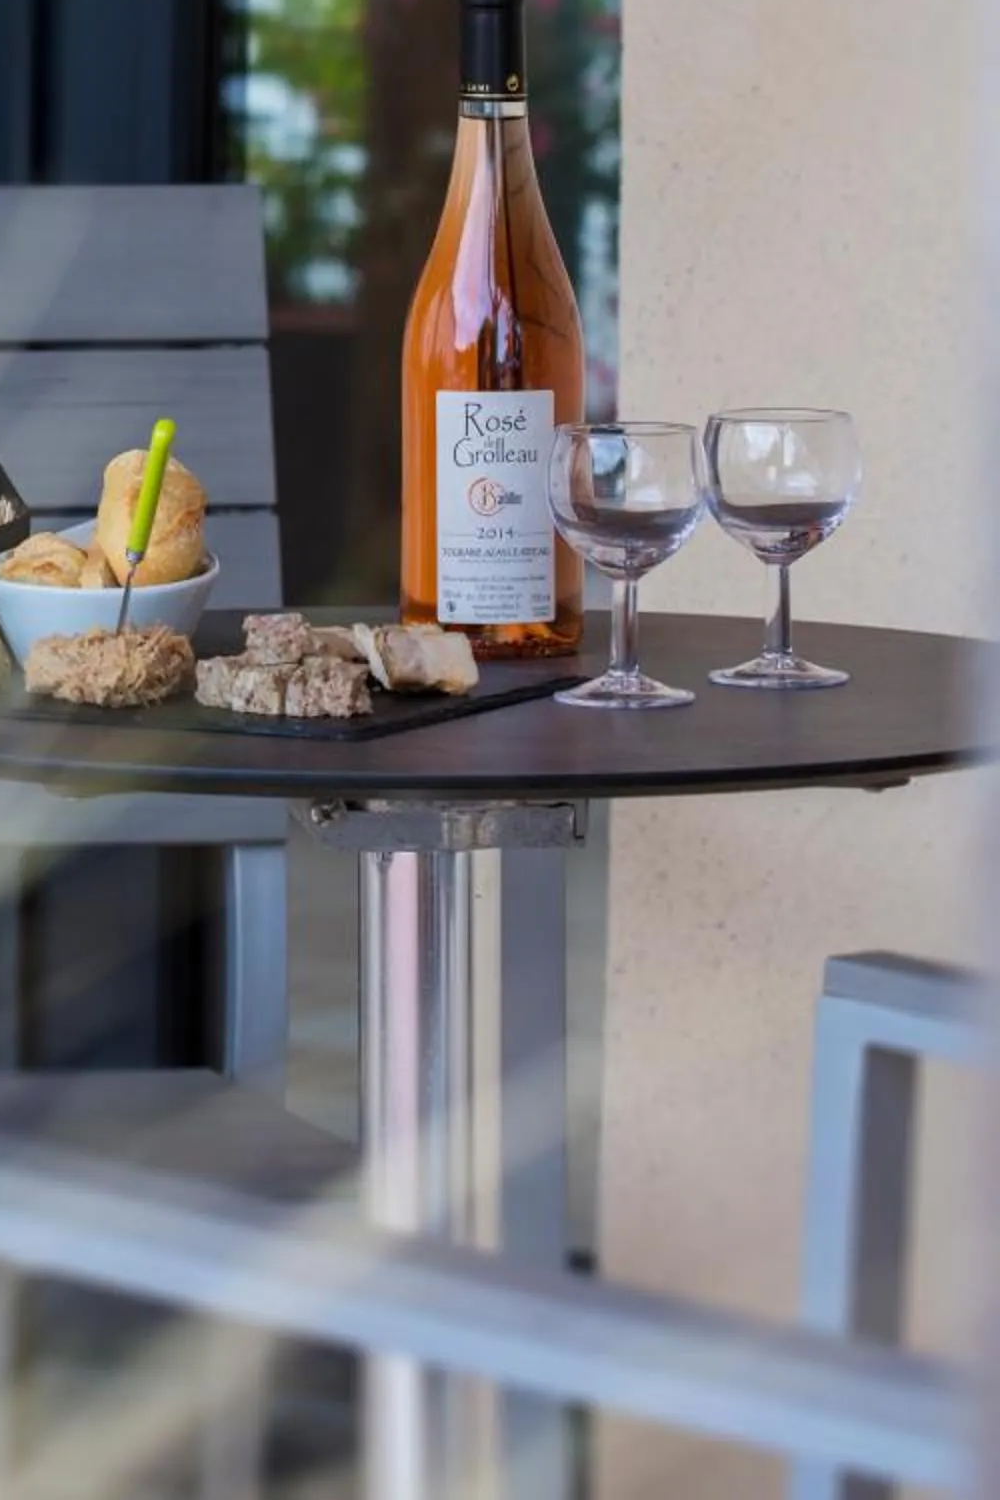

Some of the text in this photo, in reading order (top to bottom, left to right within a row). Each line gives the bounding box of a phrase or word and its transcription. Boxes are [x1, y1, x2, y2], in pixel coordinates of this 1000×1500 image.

[464, 402, 528, 436] Rosé
[453, 437, 538, 468] Grolleau
[477, 526, 514, 539] 2014
